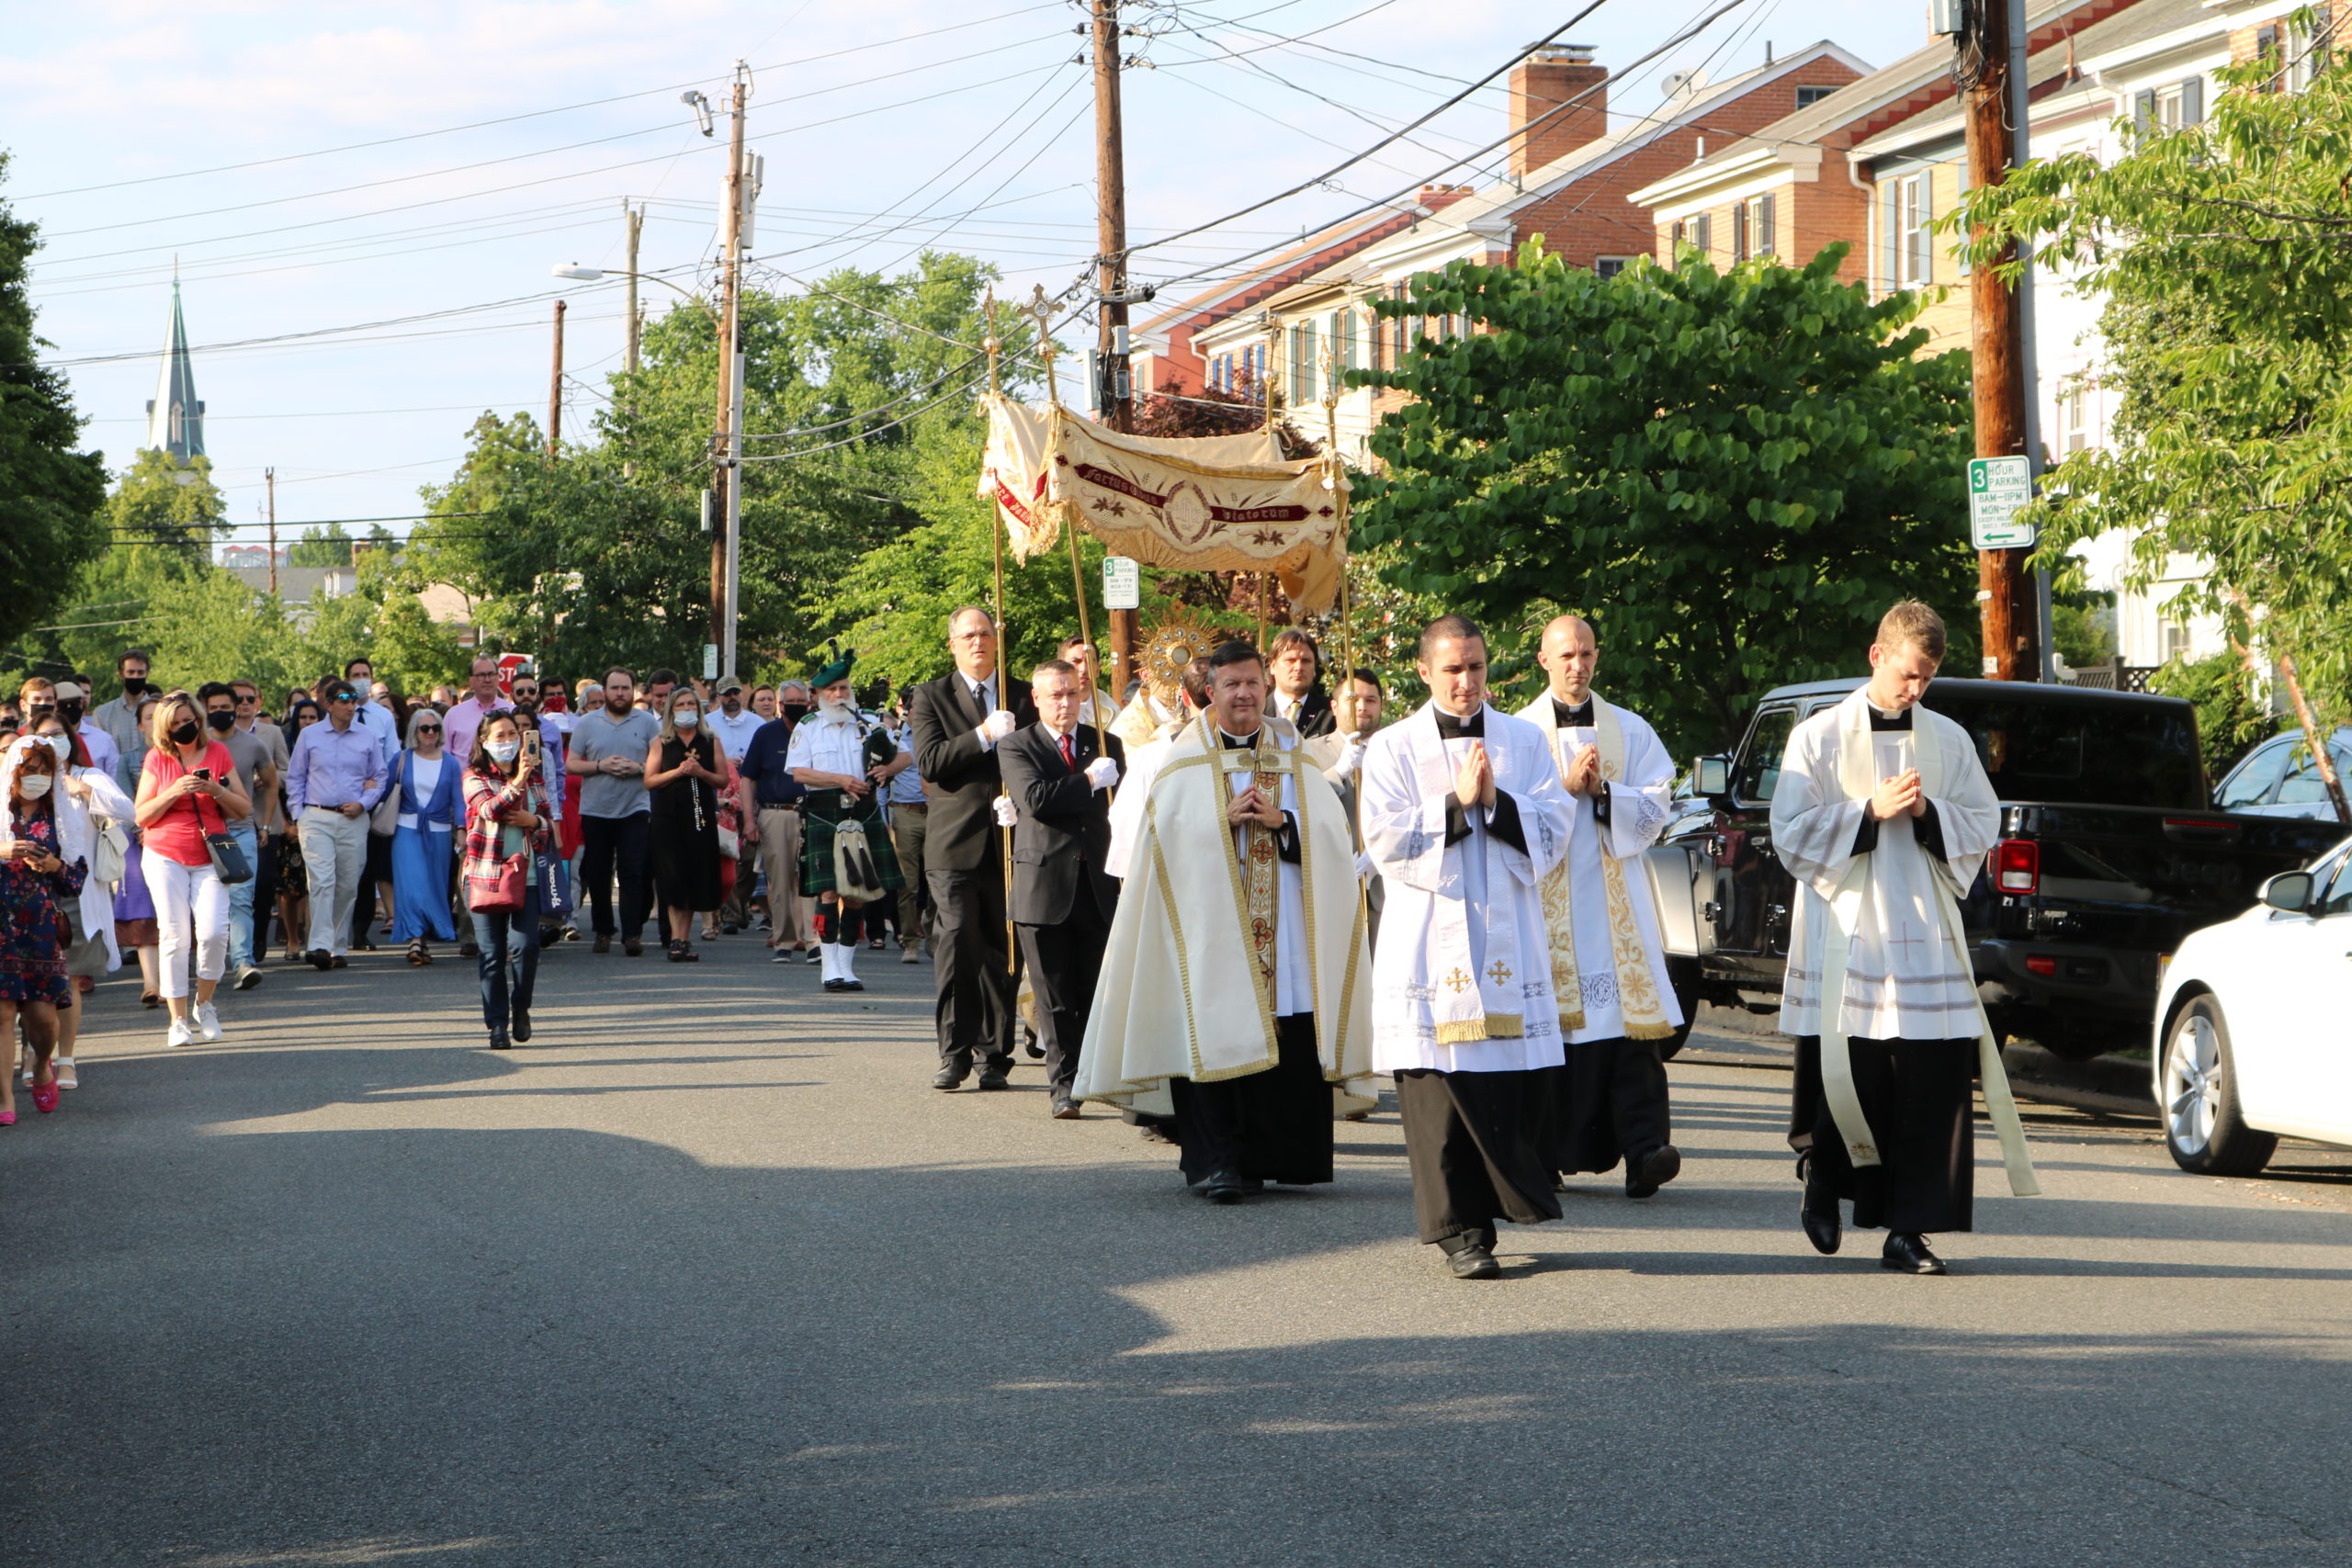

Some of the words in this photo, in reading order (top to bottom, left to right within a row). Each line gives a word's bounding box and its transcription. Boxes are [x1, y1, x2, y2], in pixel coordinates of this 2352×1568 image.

[1988, 465, 2014, 476] HOUR
[1973, 468, 1985, 488] 3
[1988, 476, 2026, 486] PARKING
[1106, 562, 1113, 574] 3
